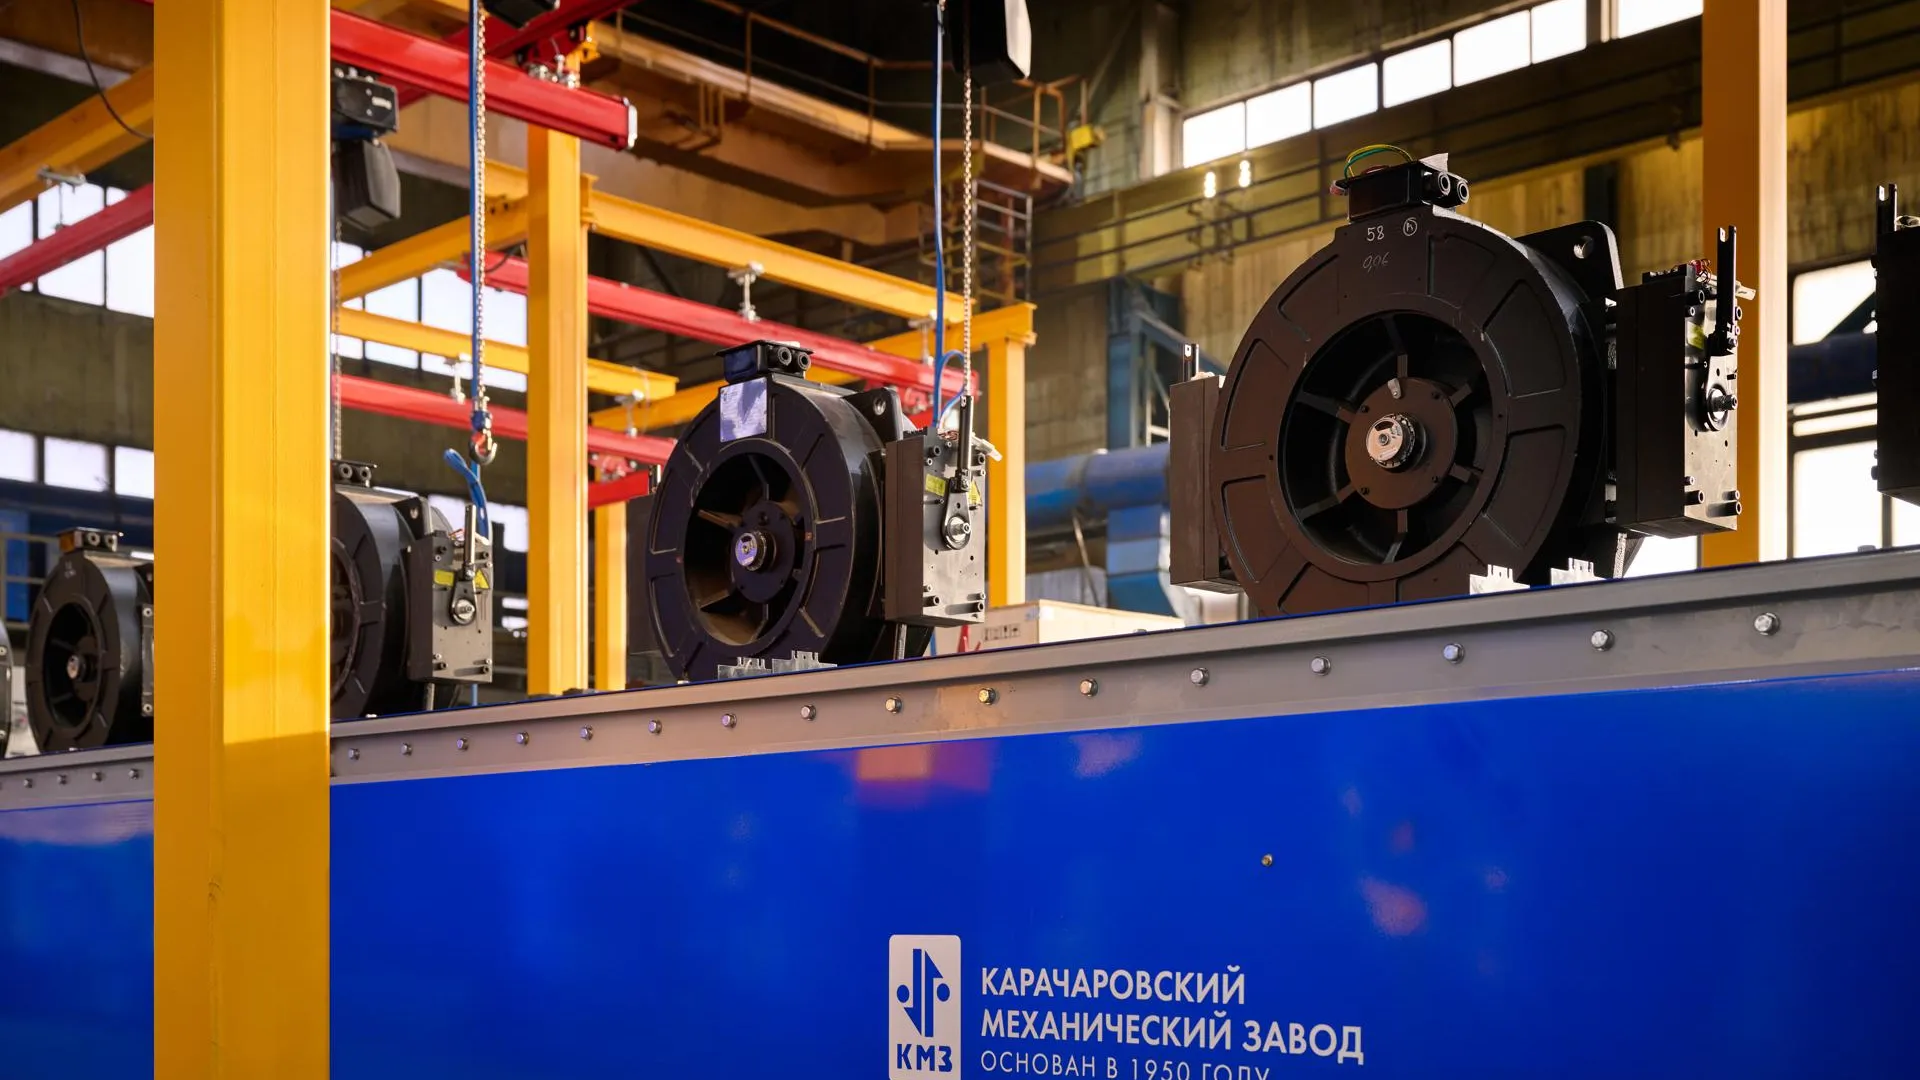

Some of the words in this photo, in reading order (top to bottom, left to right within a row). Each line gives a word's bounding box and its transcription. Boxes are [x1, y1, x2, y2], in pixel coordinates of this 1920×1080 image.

[1366, 225, 1385, 241] 58
[981, 964, 1245, 1005] КАРАЧАРОВСКИЙ
[980, 1009, 1232, 1051] МЕХАНИЧЕСКИЙ
[1242, 1019, 1364, 1066] ЗАВОД
[896, 1043, 953, 1073] КМЗ
[980, 1050, 1096, 1078] ОСНОВАН
[1106, 1056, 1118, 1079] В
[1131, 1058, 1190, 1080] 1950
